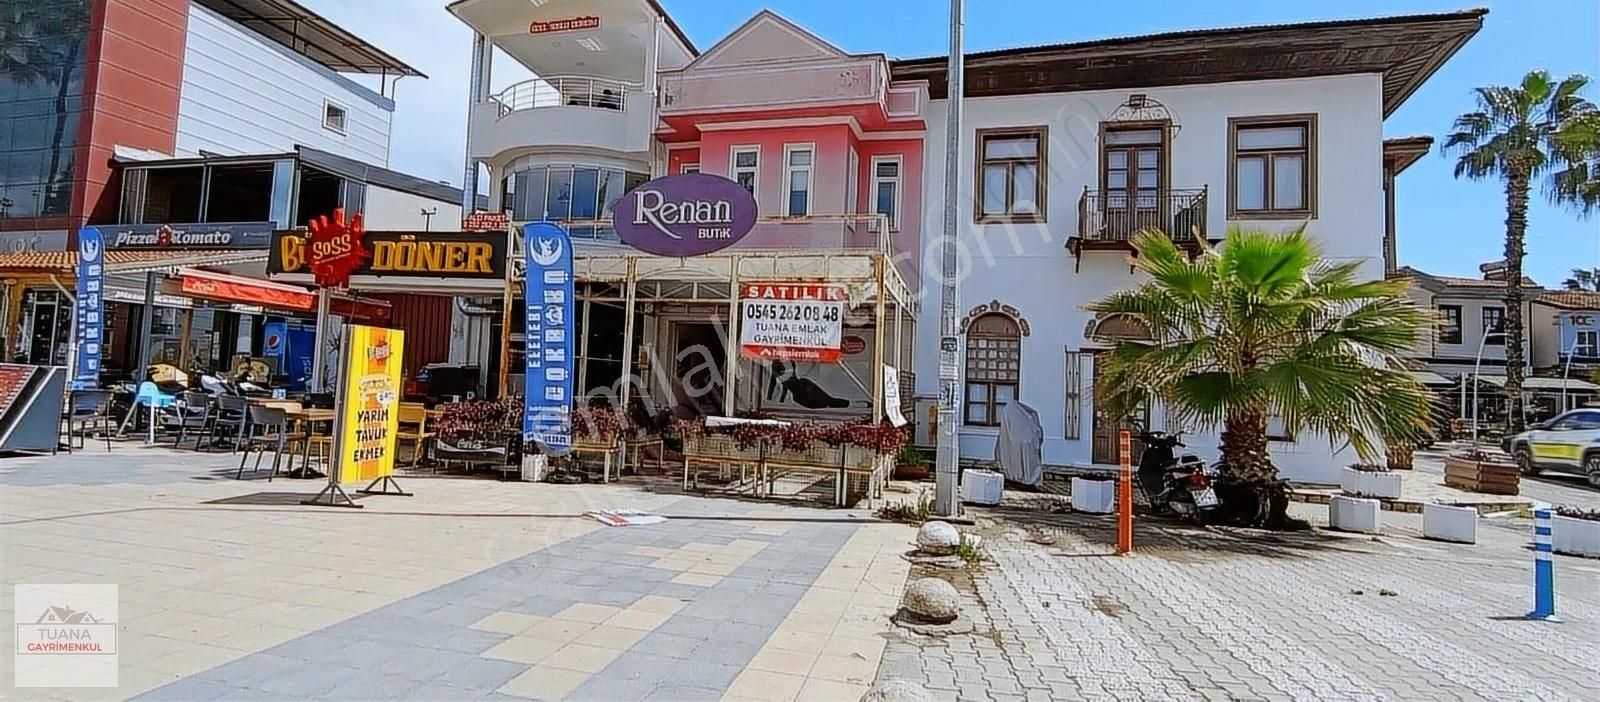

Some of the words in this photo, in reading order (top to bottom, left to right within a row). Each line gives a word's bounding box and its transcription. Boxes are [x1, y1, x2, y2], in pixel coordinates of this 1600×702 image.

[632, 190, 732, 239] Renan
[370, 235, 493, 273] DÖNER
[748, 286, 839, 300] SATILIK
[747, 304, 776, 320] 0545
[780, 305, 800, 320] 262
[803, 306, 820, 320] 08
[823, 306, 838, 321] 48
[756, 323, 789, 331] TUANA
[792, 324, 827, 333] EMLAK
[357, 409, 389, 423] YARIM
[356, 430, 387, 442] TAVUK
[354, 448, 385, 462] EKMEK
